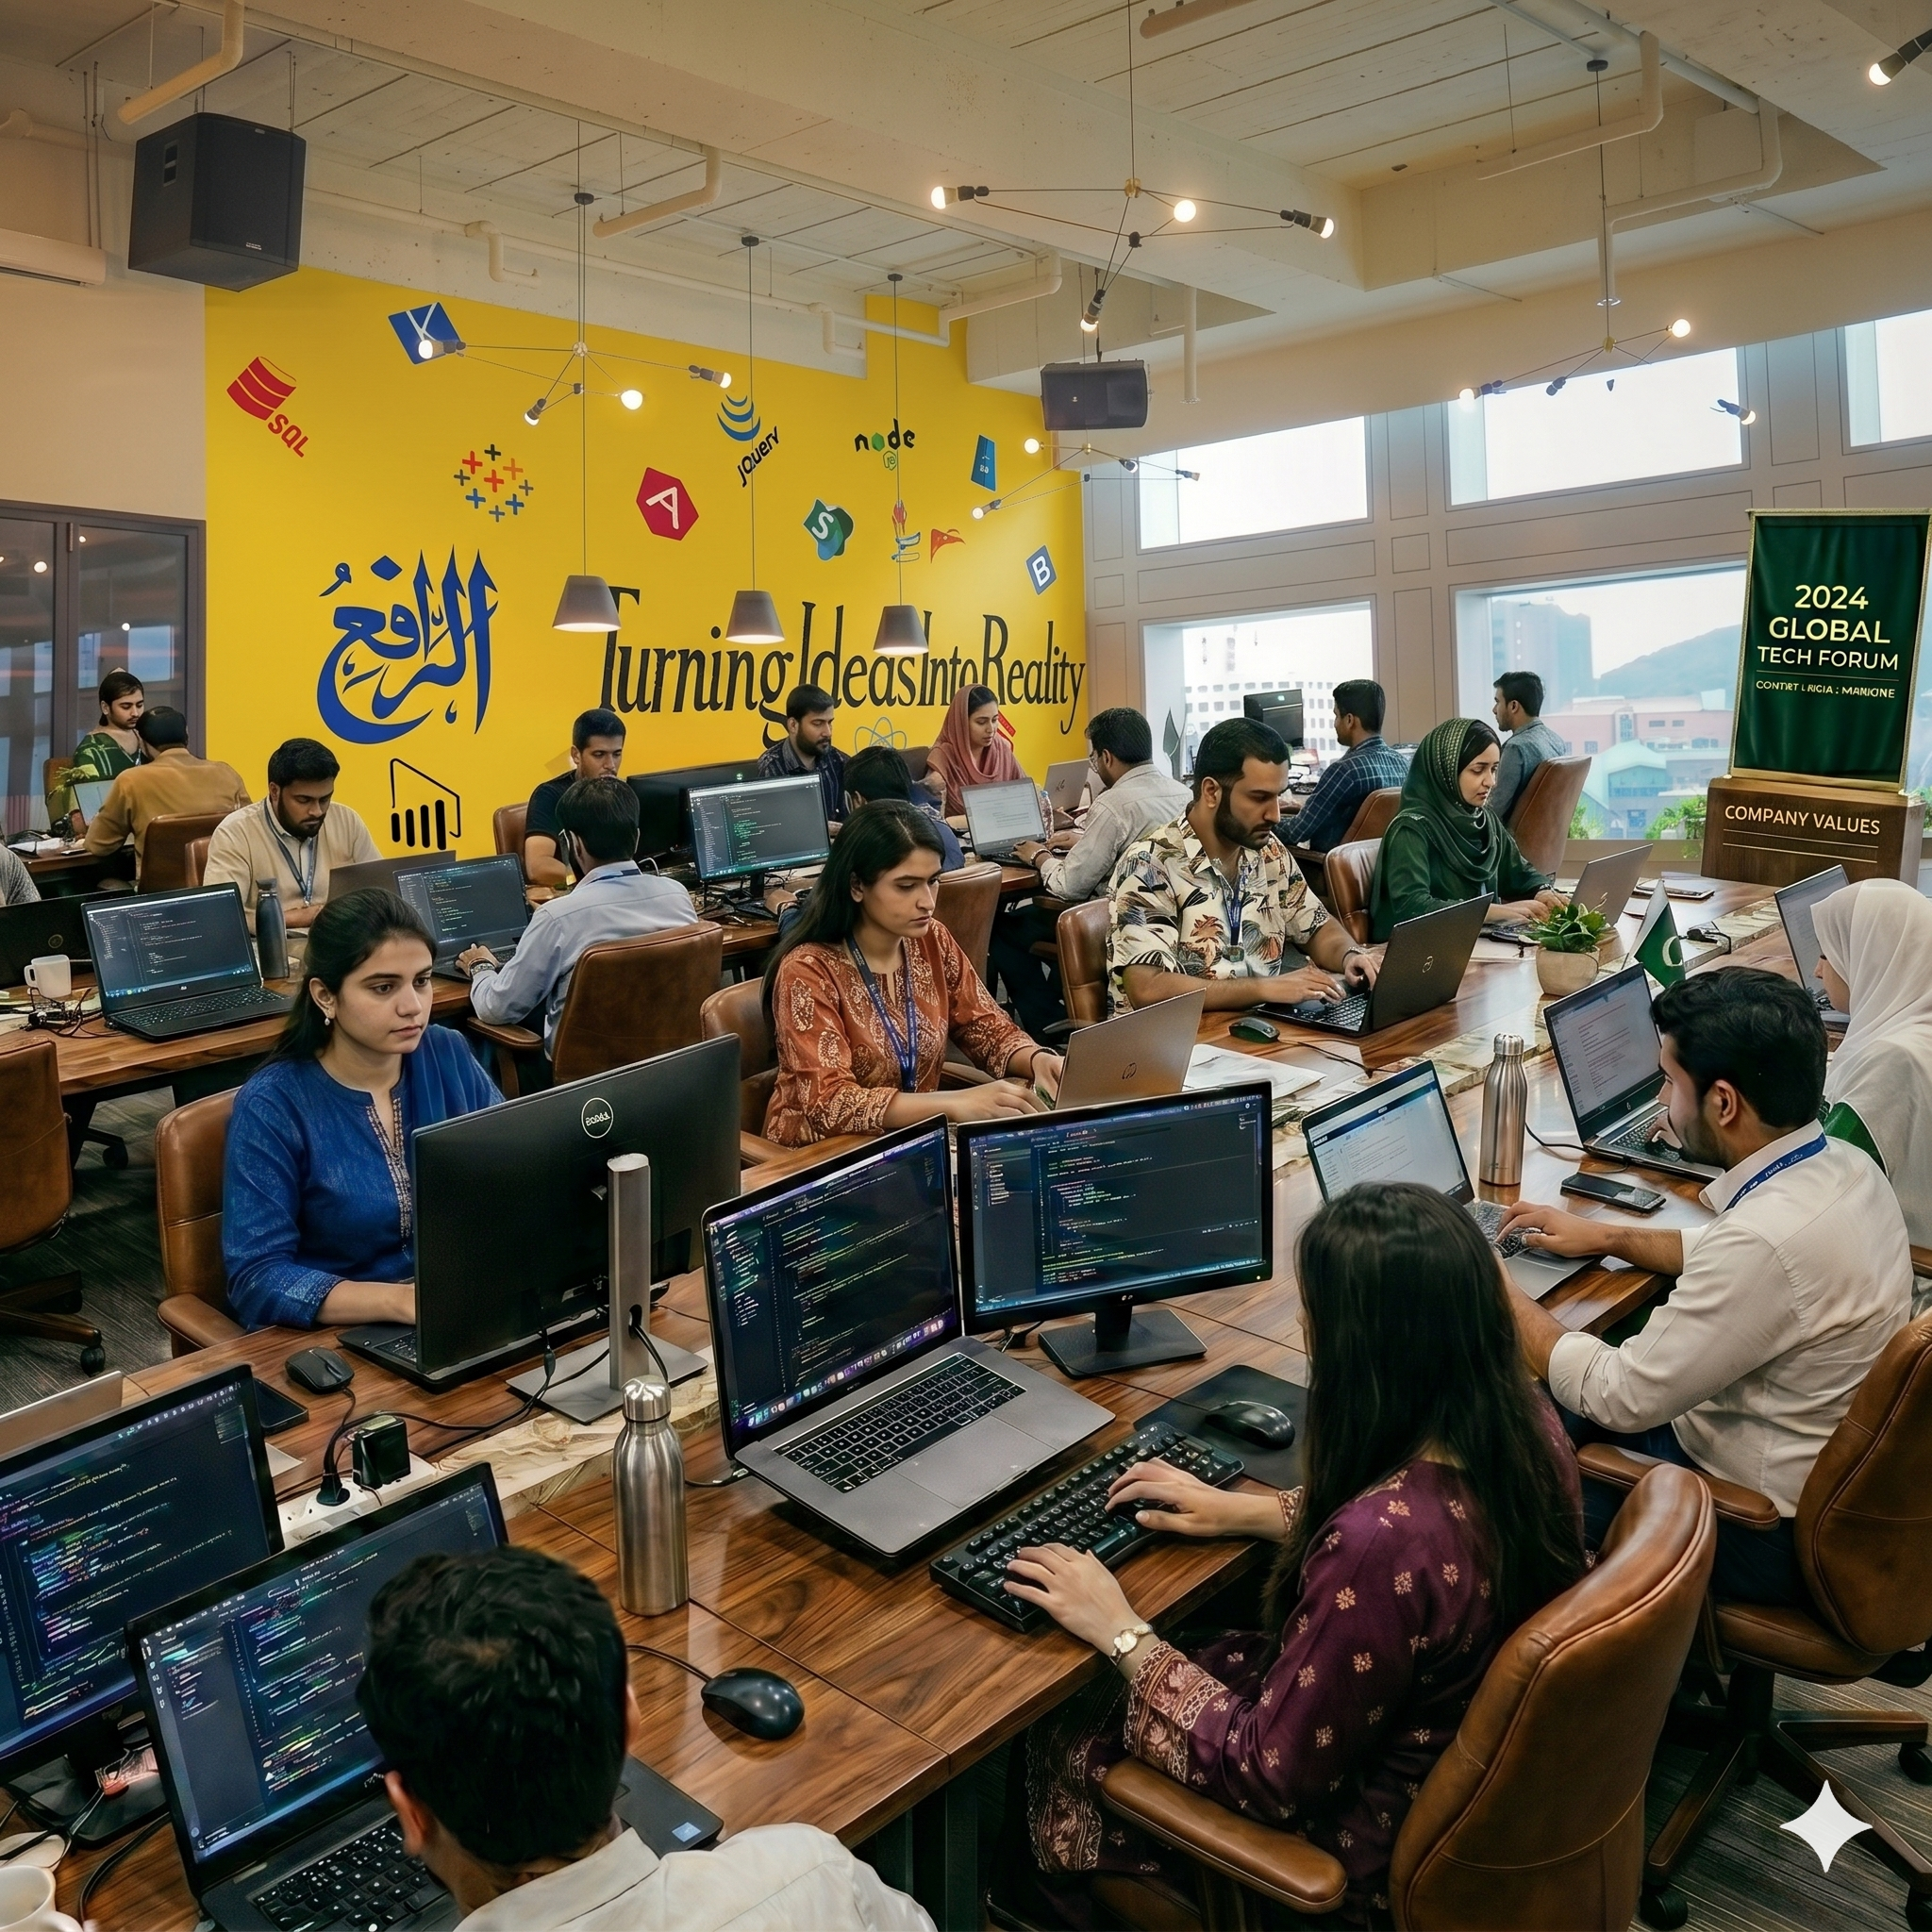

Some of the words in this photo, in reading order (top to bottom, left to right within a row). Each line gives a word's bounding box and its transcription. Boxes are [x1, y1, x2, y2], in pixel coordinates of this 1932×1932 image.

[267, 413, 309, 458] SQL
[645, 486, 680, 530] A
[811, 510, 834, 540] S
[1031, 555, 1051, 587] B
[1794, 584, 1869, 609] 2024
[1769, 616, 1890, 644] GLOBAL
[598, 585, 794, 749] Turning
[798, 600, 917, 708] Ideas
[916, 609, 978, 707] Into
[981, 614, 1086, 735] Reality
[1757, 645, 1812, 666] TECH
[1818, 649, 1899, 671] FORUM
[1724, 805, 1809, 826] COMPANY
[1813, 812, 1880, 835] VALUES
